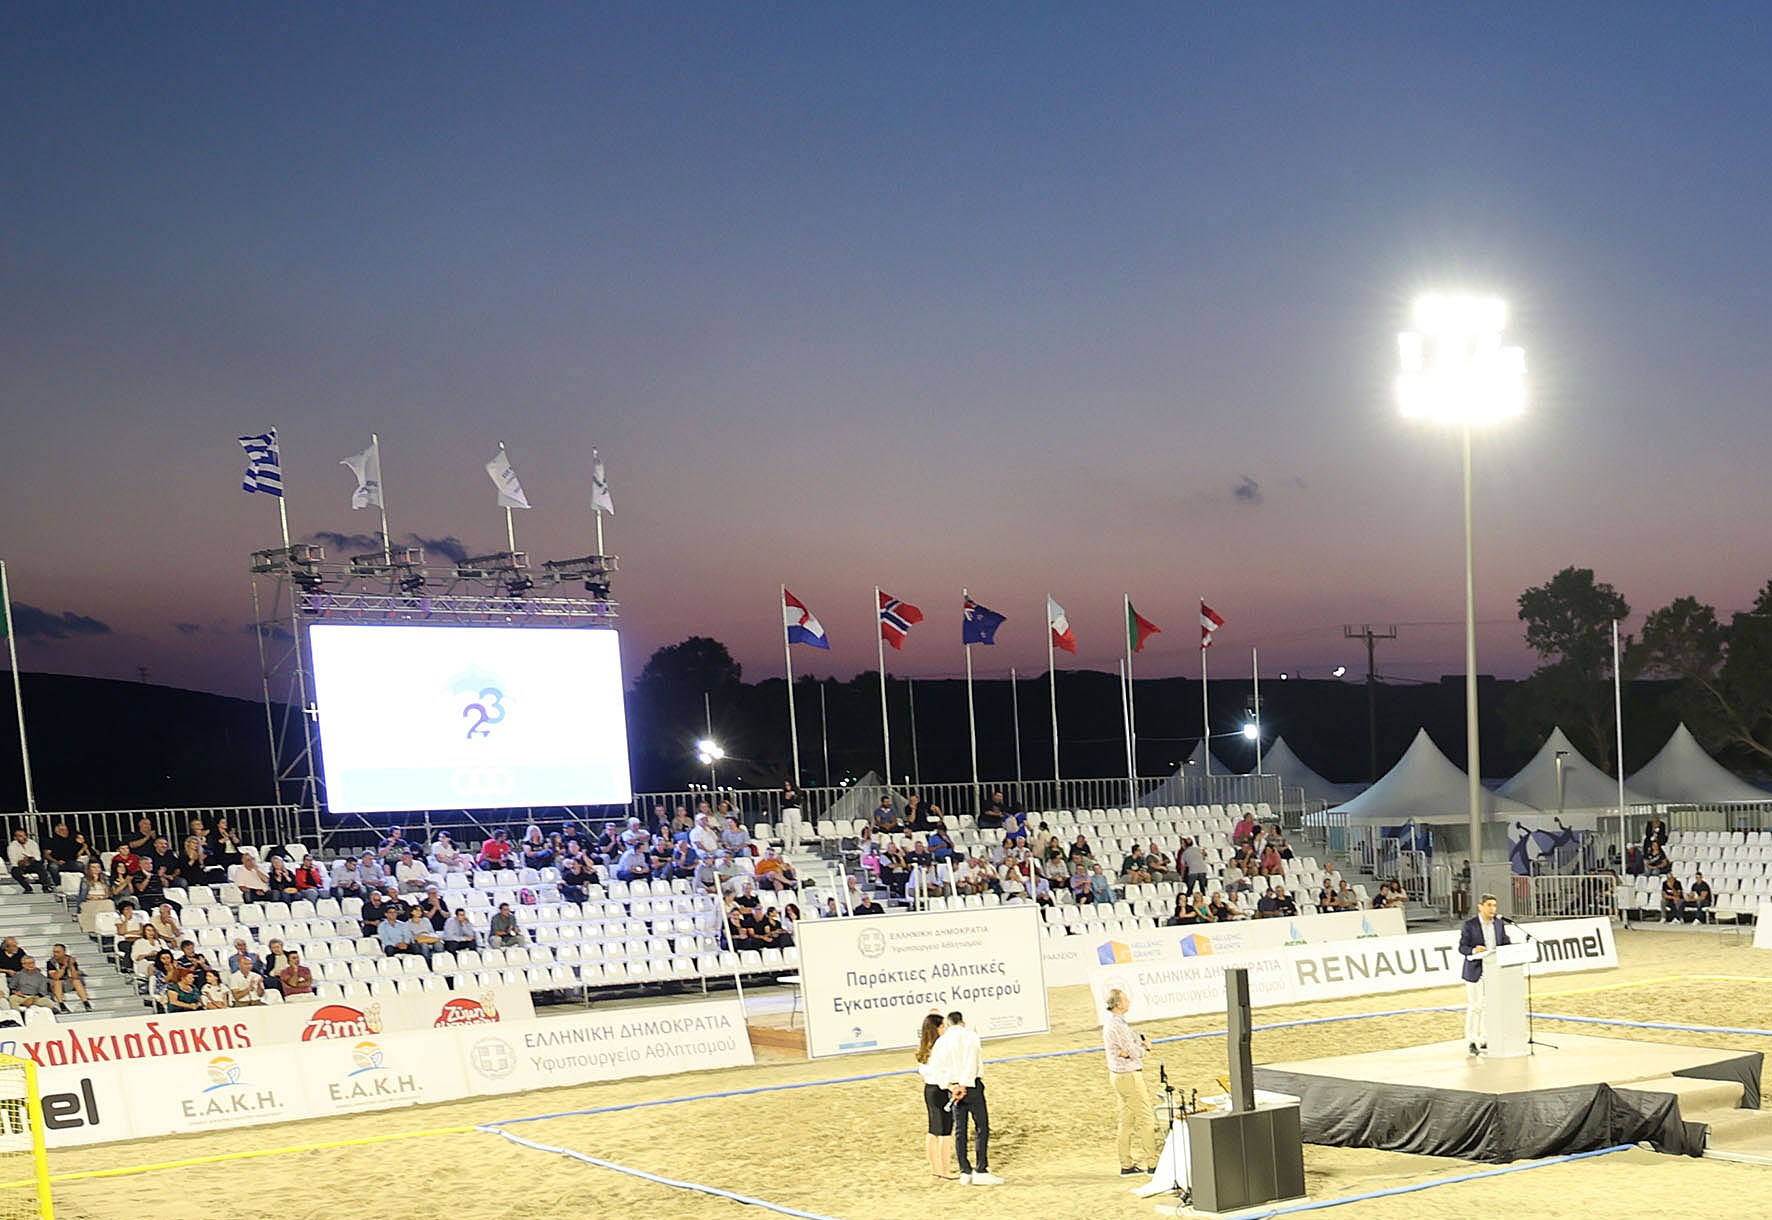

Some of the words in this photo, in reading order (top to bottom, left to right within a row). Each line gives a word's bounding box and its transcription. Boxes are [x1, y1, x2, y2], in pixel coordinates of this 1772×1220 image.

[934, 925, 989, 937] ΔΗΜΟΚΡΑΤΙΑ
[847, 967, 926, 988] Παράκτιες
[931, 960, 1005, 980] Αθλητικές
[1138, 966, 1200, 986] ΕΛΛΗΝΙΚΗ
[1295, 946, 1453, 986] RENAULT
[833, 990, 947, 1016] Εγκαταστάσεις
[952, 980, 1021, 1005] Καρτερού
[524, 1025, 614, 1048] ΕΛΛΗΝΙΚΗ
[620, 1014, 732, 1039] ΔΗΜΟΚΡΑΤΙΑ
[530, 1048, 640, 1073] Υφυπουργείο
[645, 1034, 737, 1061] Αθλητισμού
